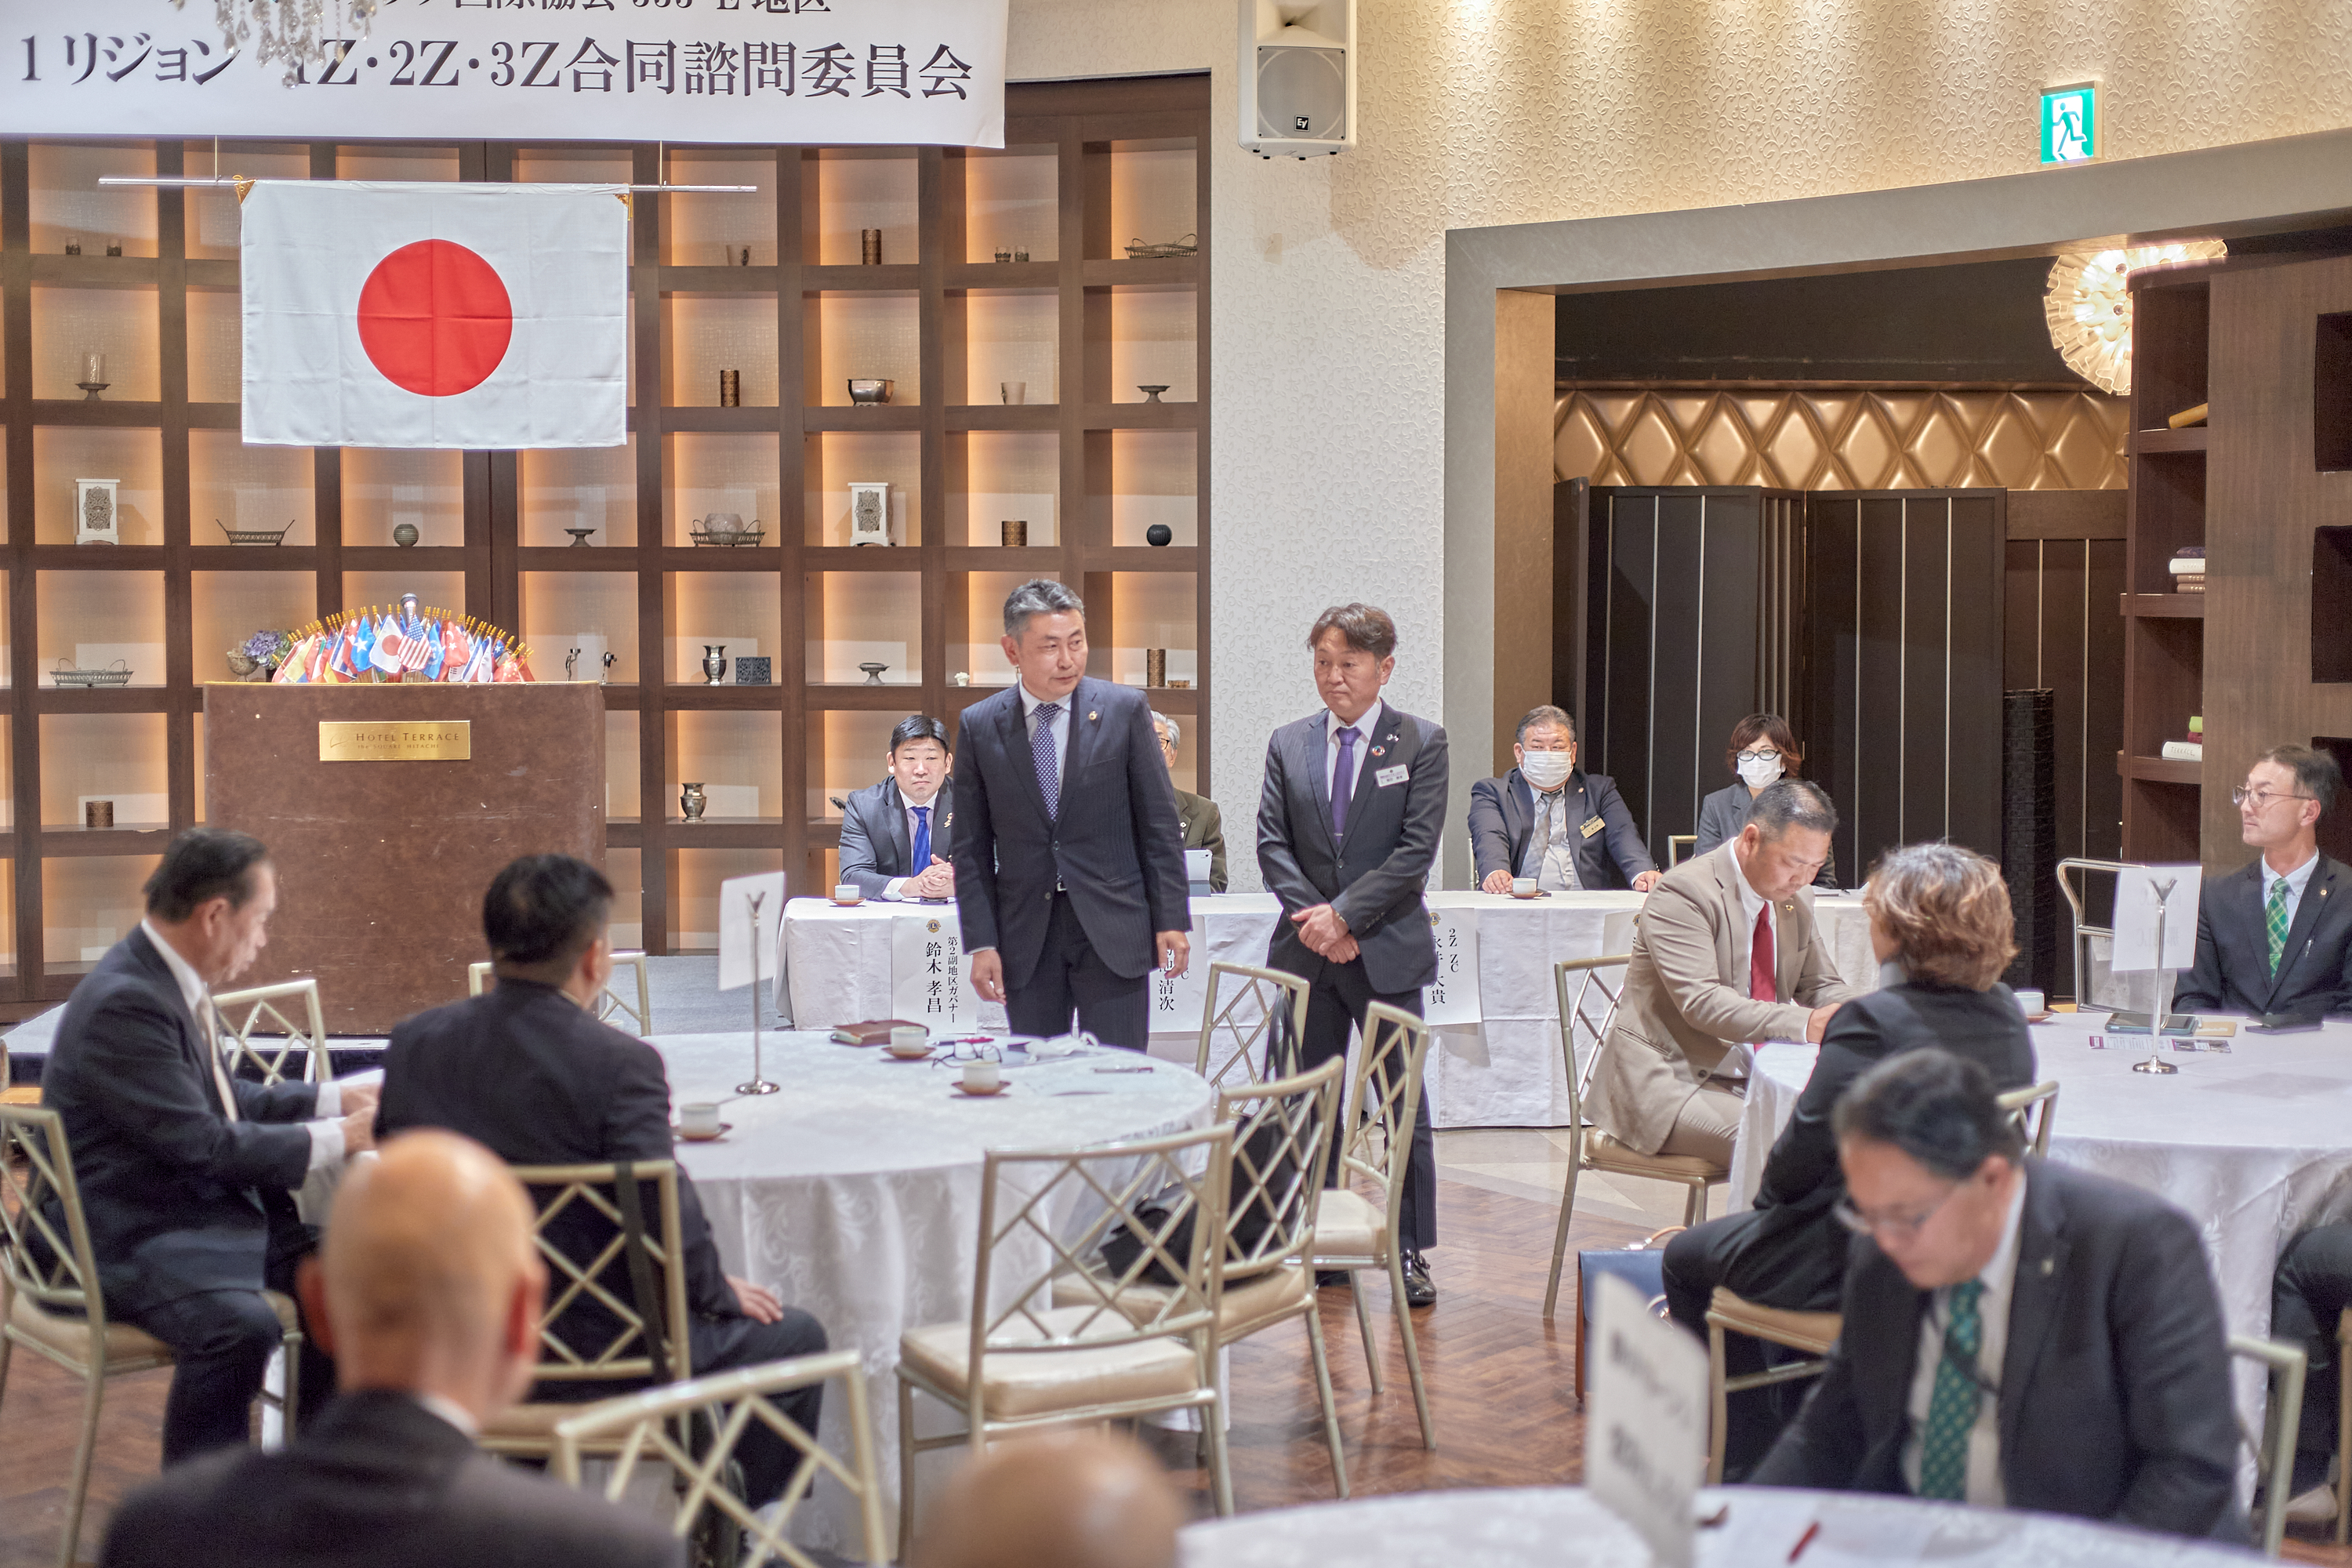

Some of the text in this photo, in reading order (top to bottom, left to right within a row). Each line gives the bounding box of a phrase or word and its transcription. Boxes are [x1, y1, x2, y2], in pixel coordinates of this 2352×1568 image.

[356, 732, 459, 742] HOTEL TERRACE
[1449, 928, 1459, 973] 2Z ZC
[947, 936, 958, 1023] 第2副地区ガバナー
